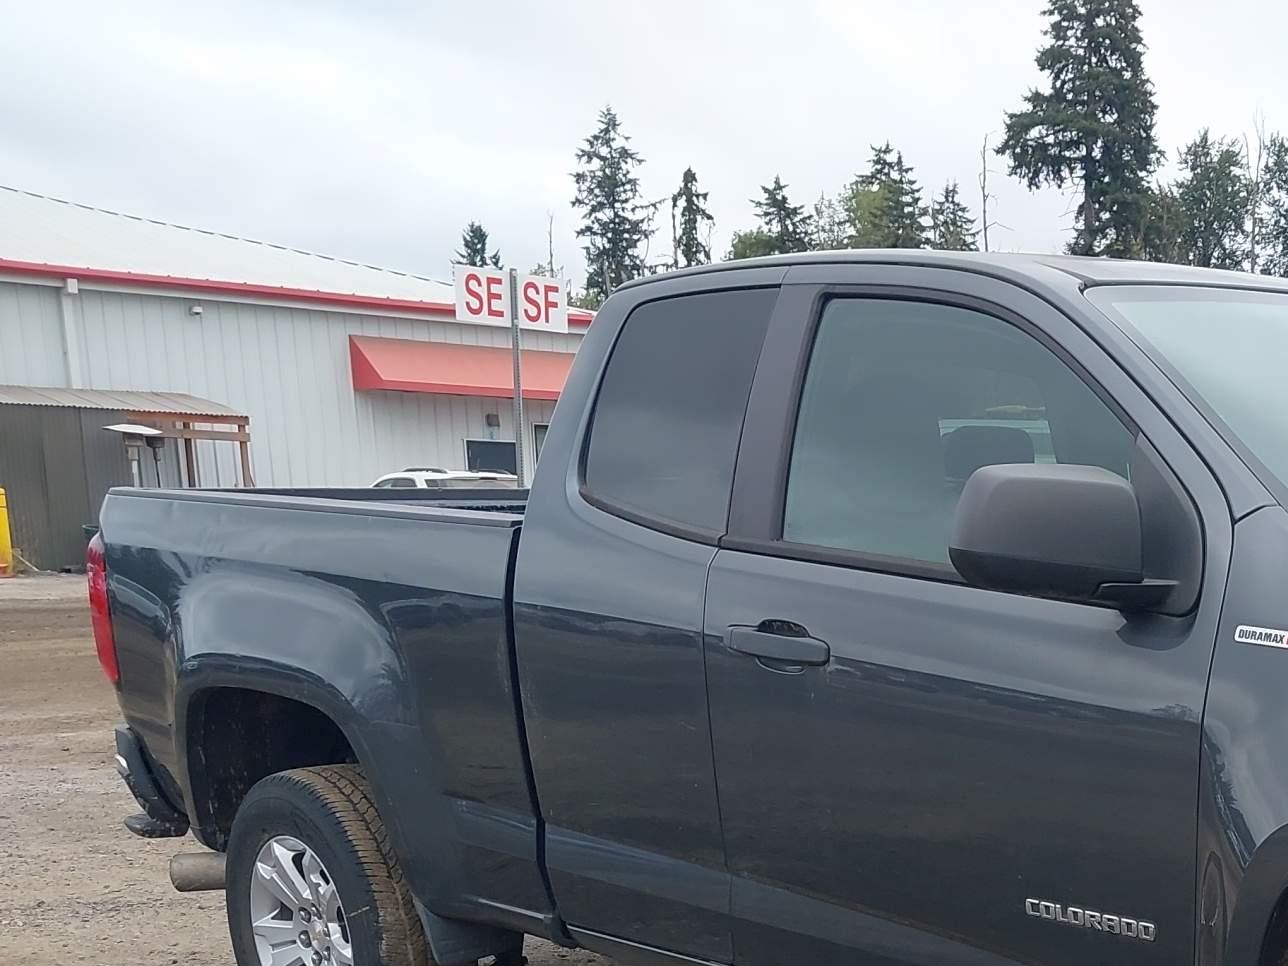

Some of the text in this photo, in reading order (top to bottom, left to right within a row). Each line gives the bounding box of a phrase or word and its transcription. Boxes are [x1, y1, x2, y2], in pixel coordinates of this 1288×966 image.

[464, 273, 505, 318] SE
[523, 281, 560, 324] SF
[1238, 629, 1285, 644] DURAMAX
[1025, 898, 1156, 942] COLORADO
